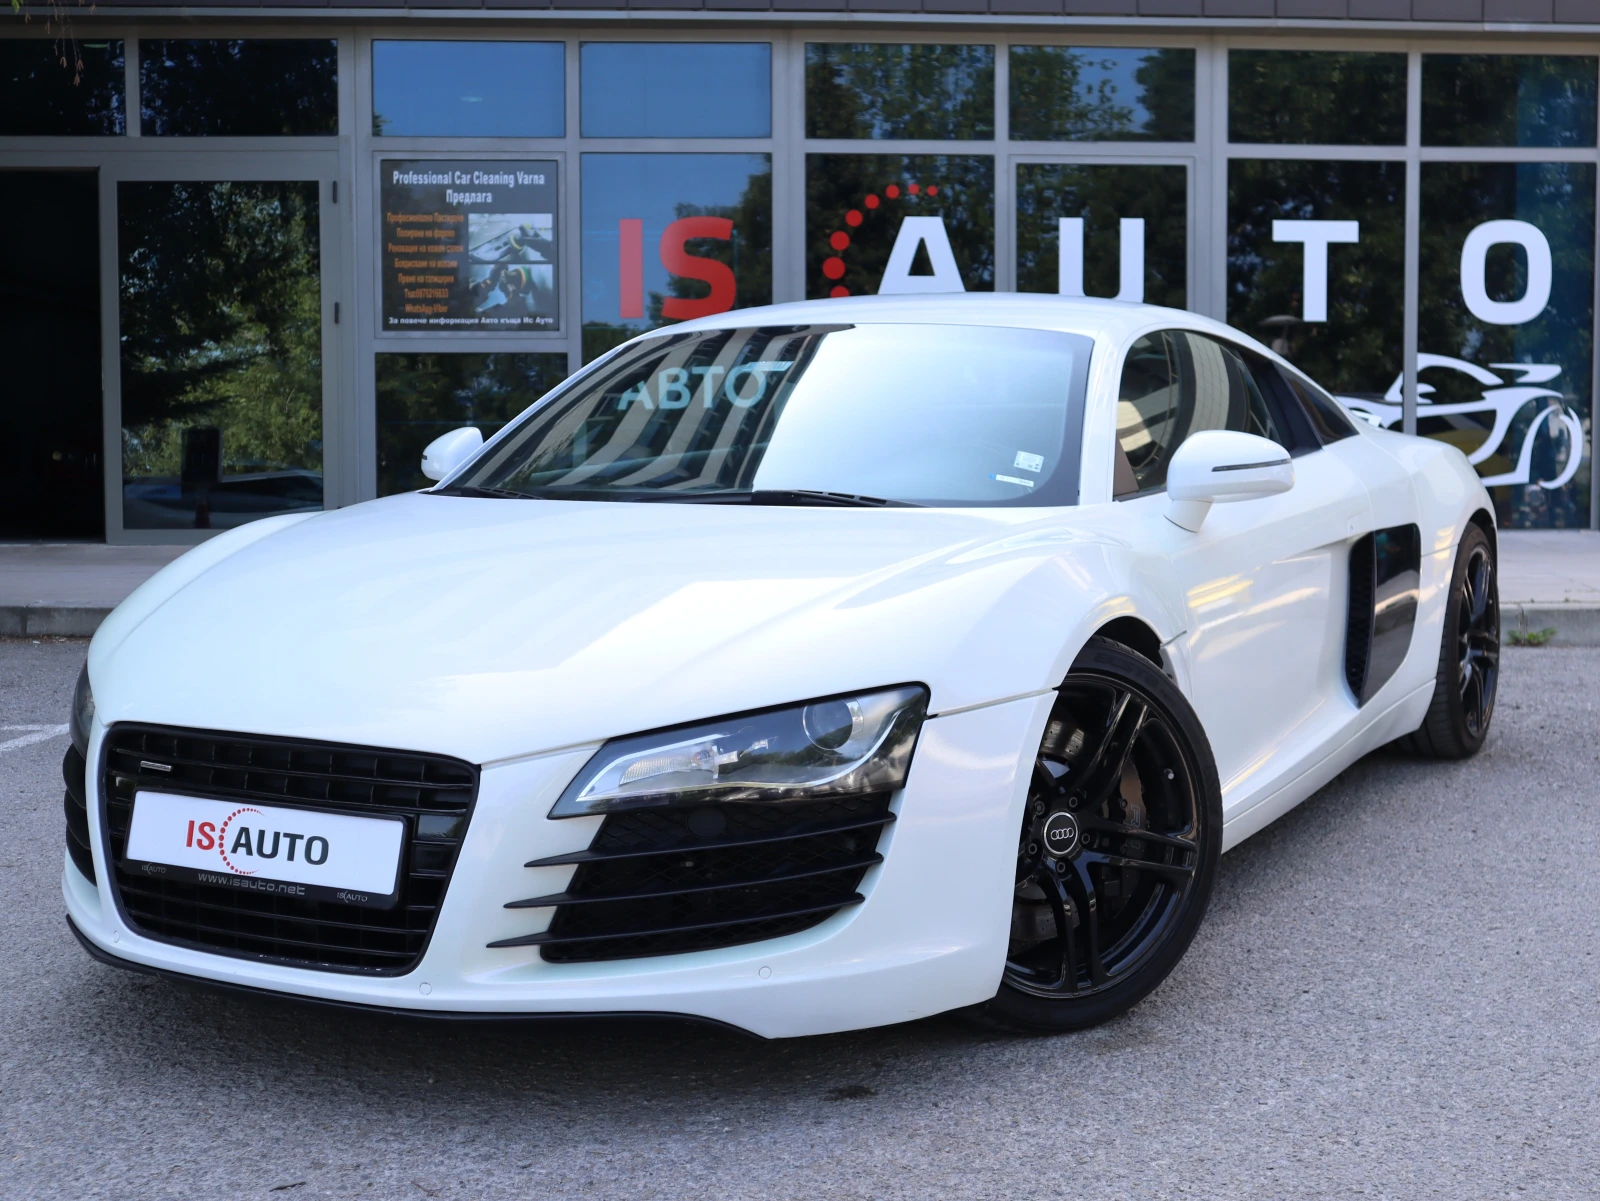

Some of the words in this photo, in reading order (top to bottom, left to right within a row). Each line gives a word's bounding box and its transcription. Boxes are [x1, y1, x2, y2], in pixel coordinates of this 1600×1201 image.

[393, 171, 452, 185] Professional
[454, 171, 471, 185] Car
[473, 171, 515, 188] Cleaning
[516, 171, 545, 185] Varna
[446, 189, 493, 206] Предлага
[619, 216, 736, 320] IS
[388, 316, 399, 325] За
[428, 316, 479, 326] информация
[480, 316, 498, 325] Авто
[500, 318, 521, 326] къща
[523, 316, 533, 325] Ис
[535, 316, 553, 327] Ауто
[186, 820, 216, 851] IS
[230, 826, 330, 866] AUTO
[198, 872, 306, 896] www.isauto.net
